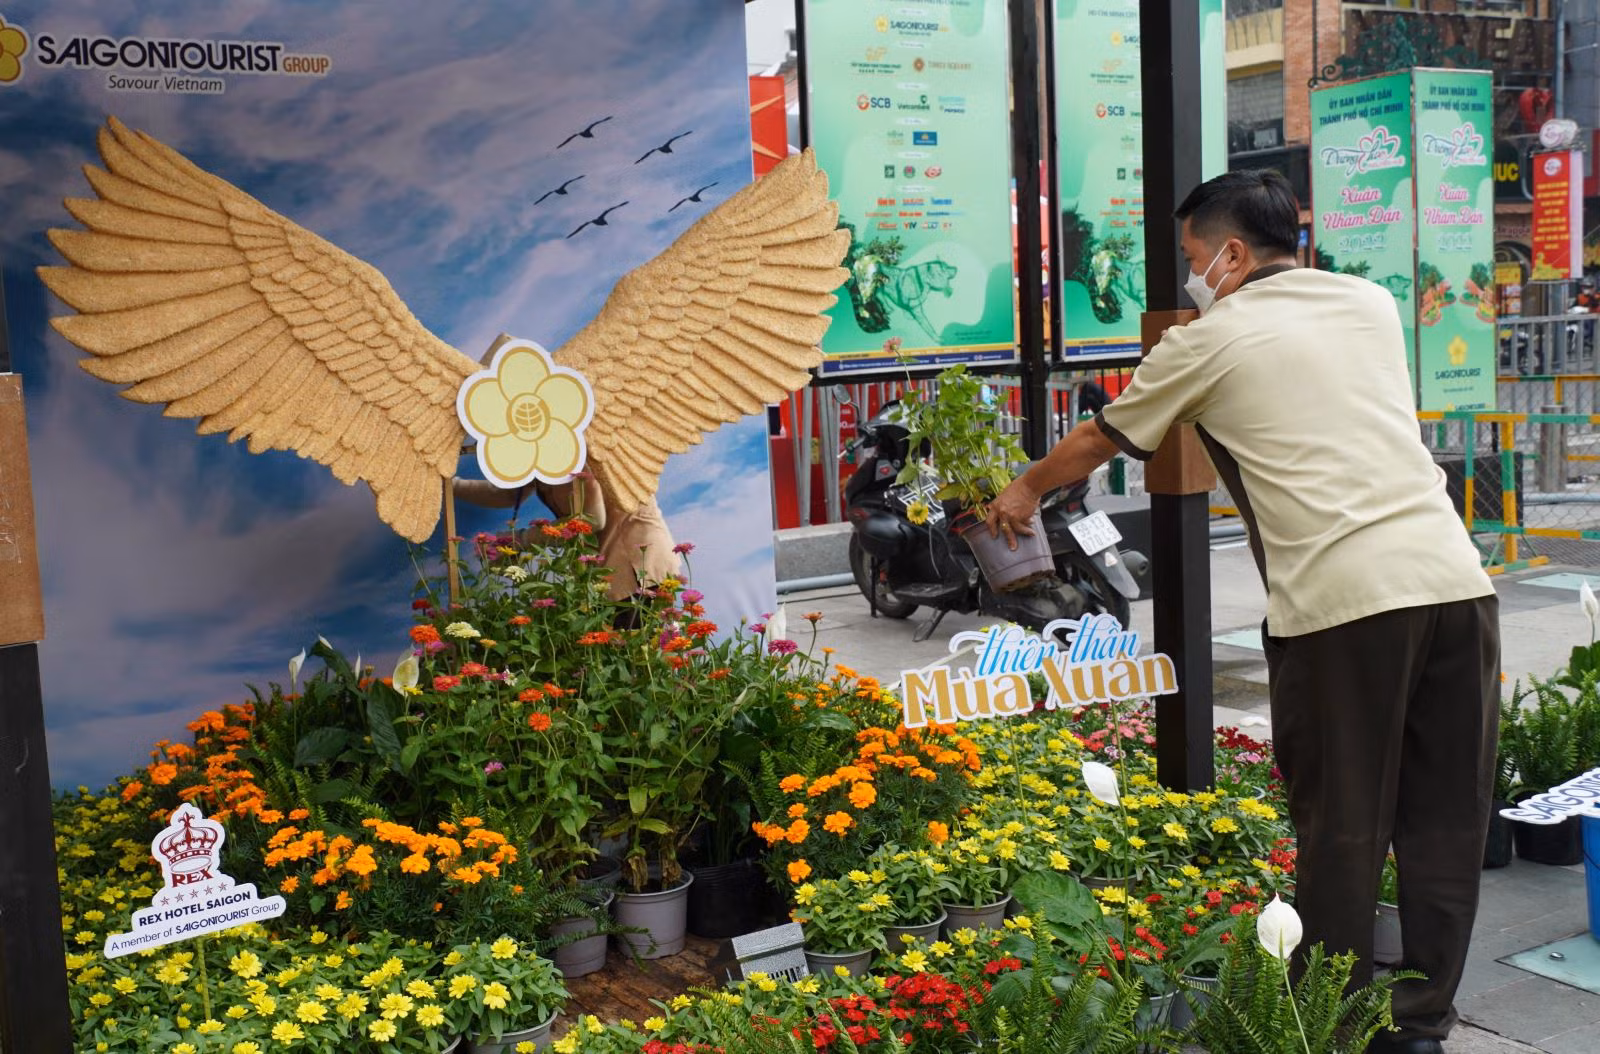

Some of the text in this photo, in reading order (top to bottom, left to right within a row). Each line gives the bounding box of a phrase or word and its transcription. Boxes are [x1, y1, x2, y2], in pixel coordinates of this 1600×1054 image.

[37, 35, 330, 74] SAIGONTOURIST GROUP
[108, 74, 223, 92] Savour Vietnam
[870, 96, 891, 109] SCB
[1107, 105, 1125, 117] SCB
[1340, 95, 1354, 107] BAN
[974, 615, 1138, 677] thiên thần
[904, 651, 1177, 726] Mùa Xuân
[171, 863, 214, 889] REX
[138, 890, 251, 927] REX HOTEL SAIGON
[111, 902, 281, 952] A member of SAIGONTOURIST Group
